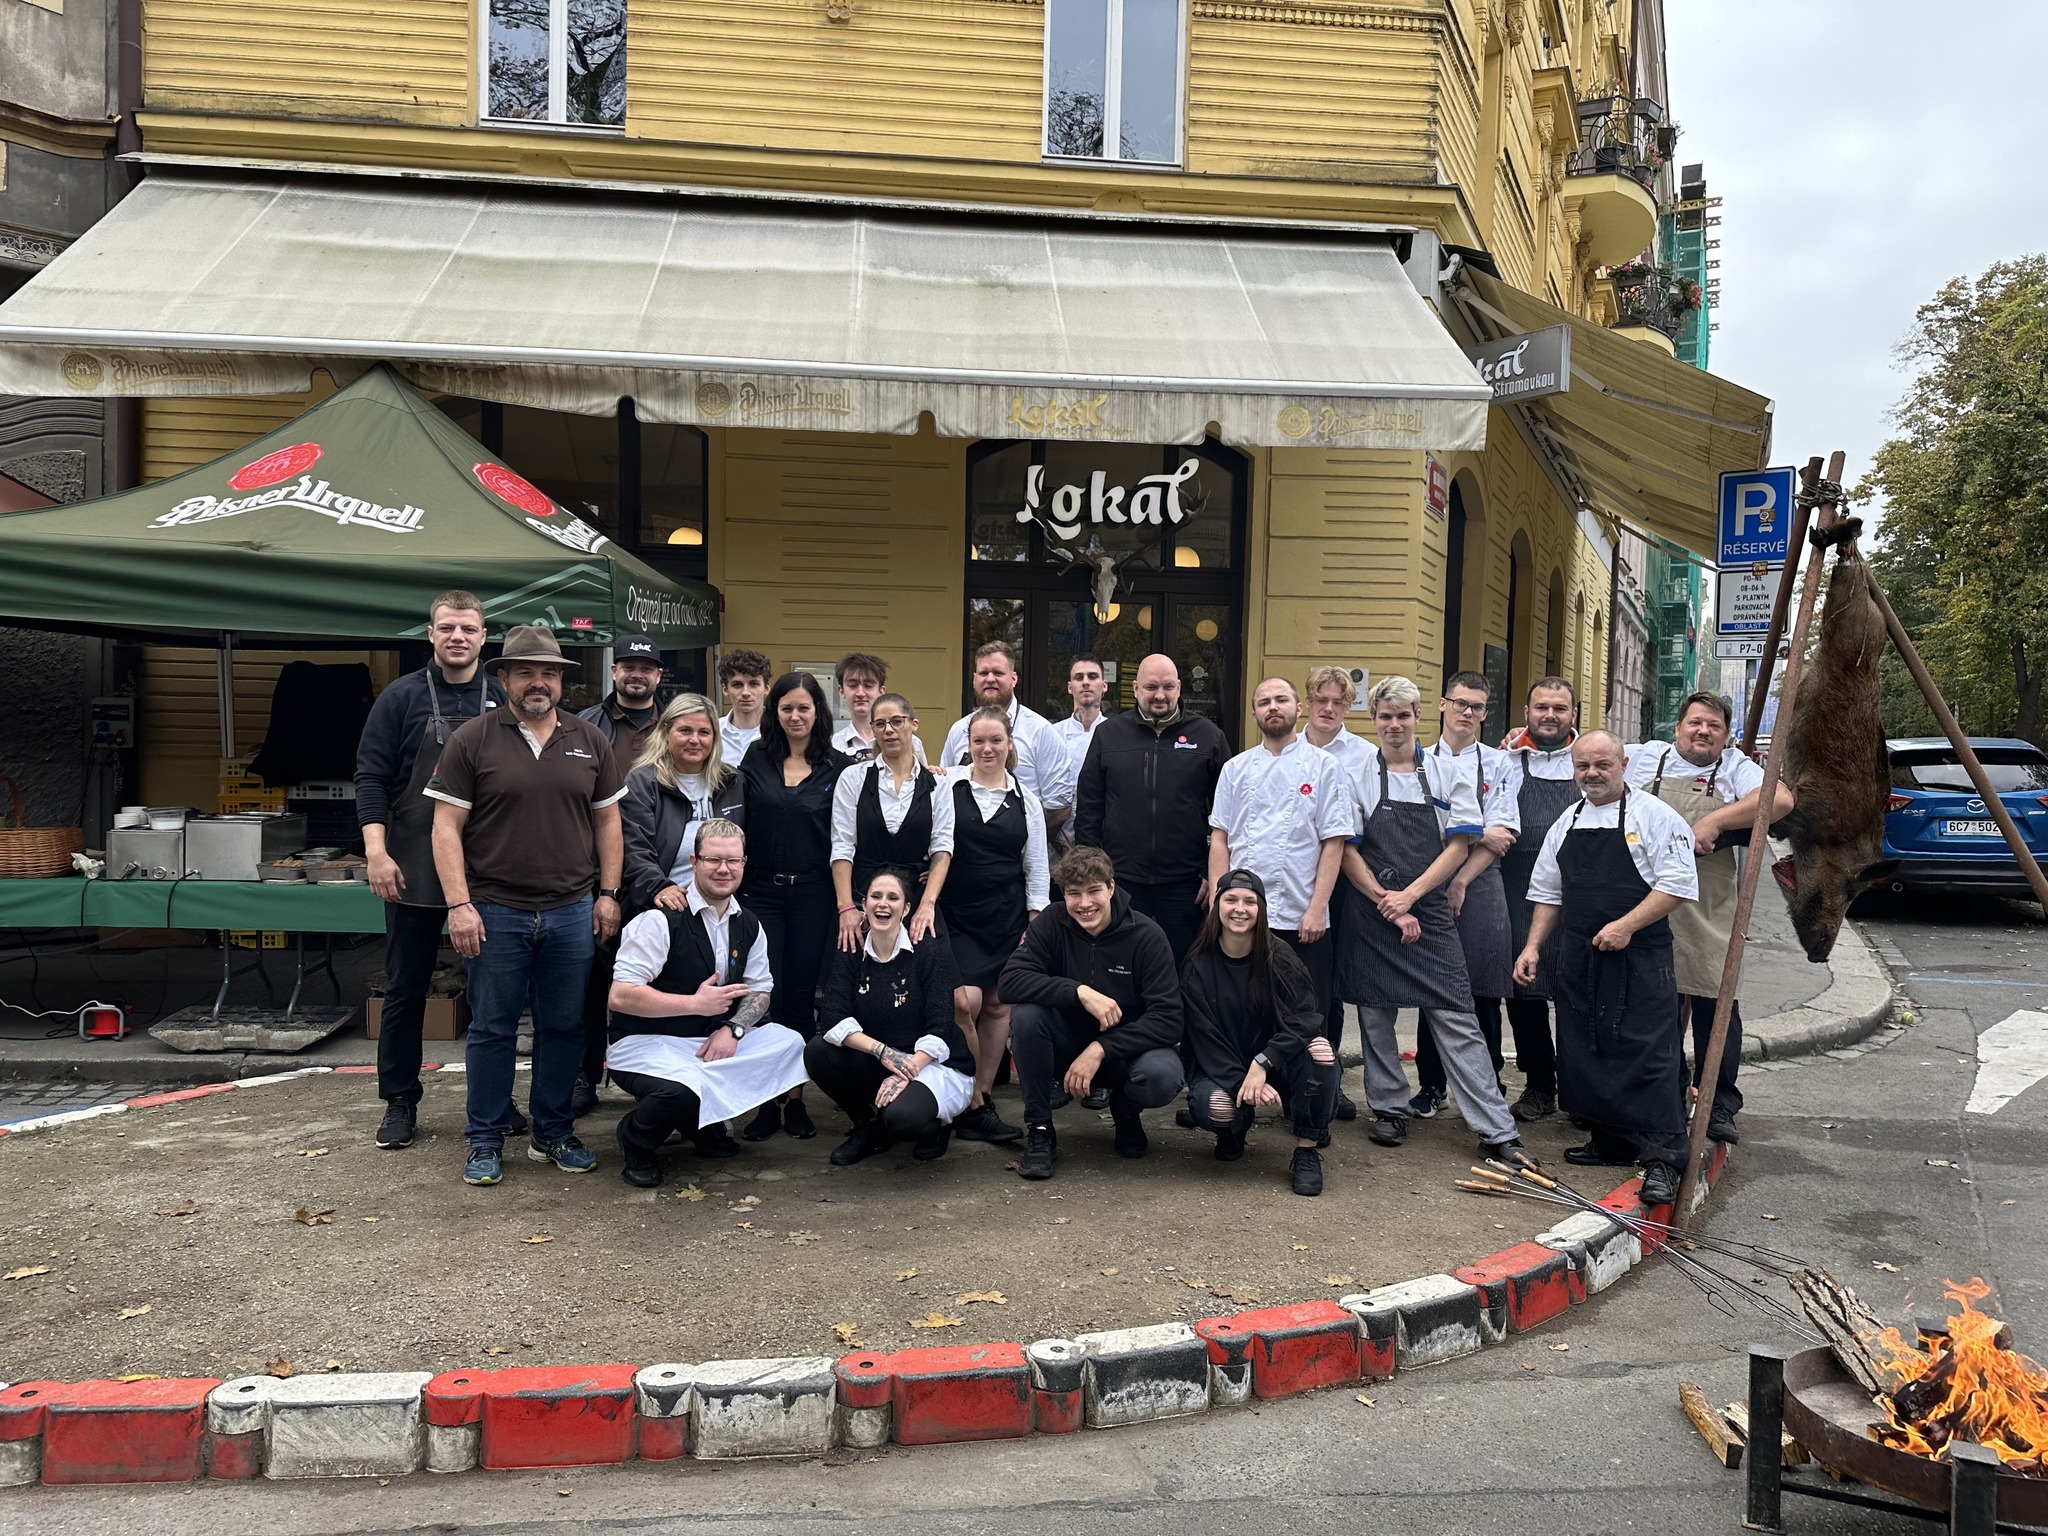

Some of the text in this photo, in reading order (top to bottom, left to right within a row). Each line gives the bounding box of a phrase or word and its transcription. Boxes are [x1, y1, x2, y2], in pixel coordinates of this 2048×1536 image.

[109, 353, 173, 392] Pilsner
[172, 355, 237, 384] Urquell
[1494, 372, 1555, 397] Stromovkou
[740, 382, 797, 421] Pilsner
[795, 382, 851, 415] Urquell
[1371, 404, 1423, 434] Urquell
[147, 485, 300, 529] Pilsner
[298, 475, 426, 529] Urquell
[1735, 482, 1777, 536] P
[1723, 539, 1786, 556] RÉSERVÉ
[1742, 592, 1770, 601] PLATNÝM
[1733, 602, 1771, 612] PARKOVACÍM
[1732, 611, 1771, 621] OPRÁVNĚNÍM
[1733, 622, 1761, 630] OBLAST
[1740, 644, 1765, 654] P7-0
[1949, 821, 1999, 832] 6C7 502
